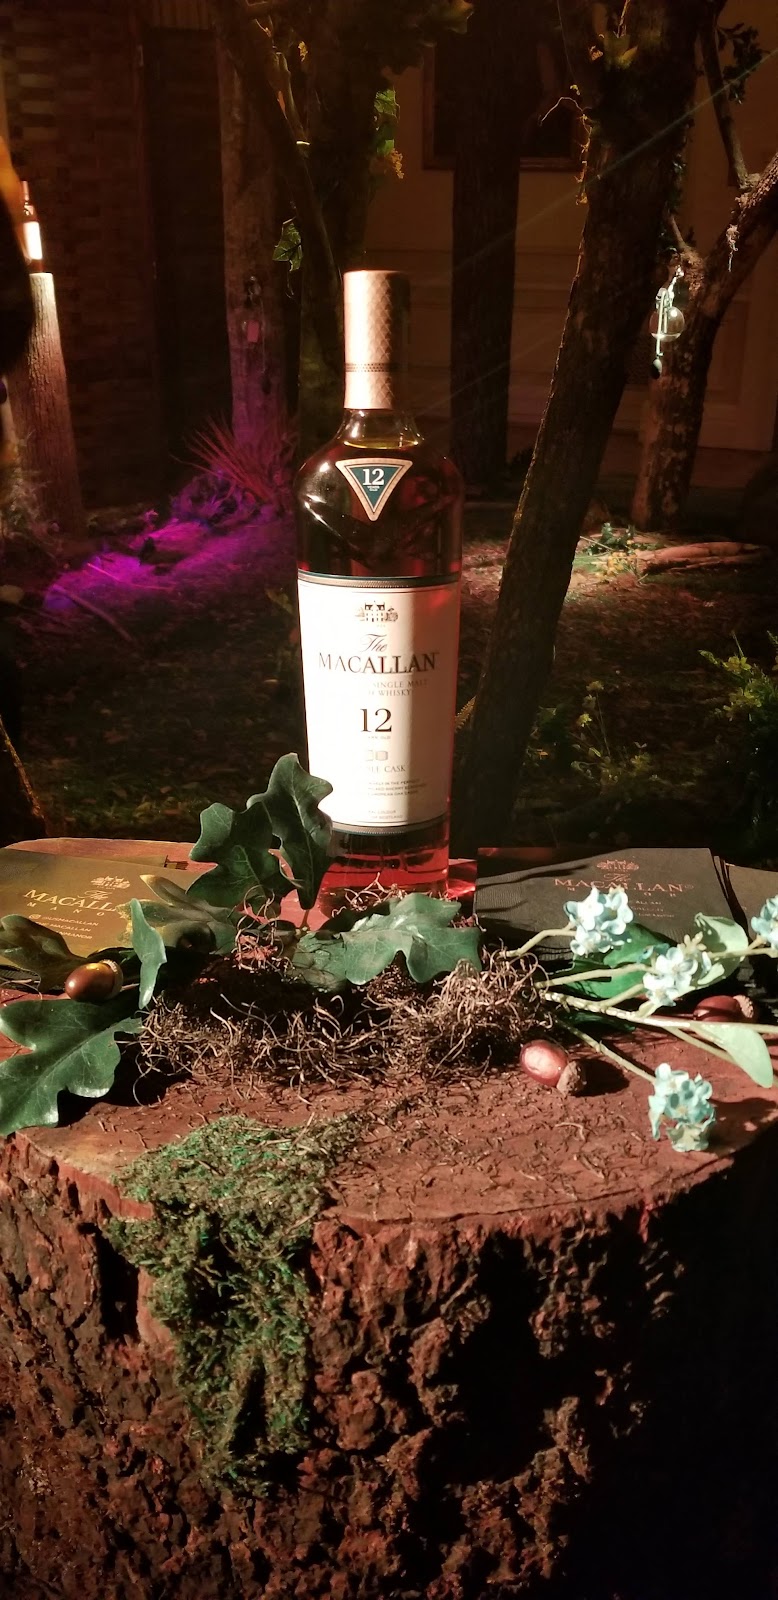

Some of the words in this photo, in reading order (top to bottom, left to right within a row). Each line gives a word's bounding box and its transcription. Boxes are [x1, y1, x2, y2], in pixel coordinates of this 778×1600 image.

[363, 468, 385, 486] 12
[360, 633, 388, 652] The
[319, 652, 437, 674] MACALLAN
[360, 708, 392, 732] 12
[384, 765, 406, 773] CASK
[23, 889, 116, 911] MACALL
